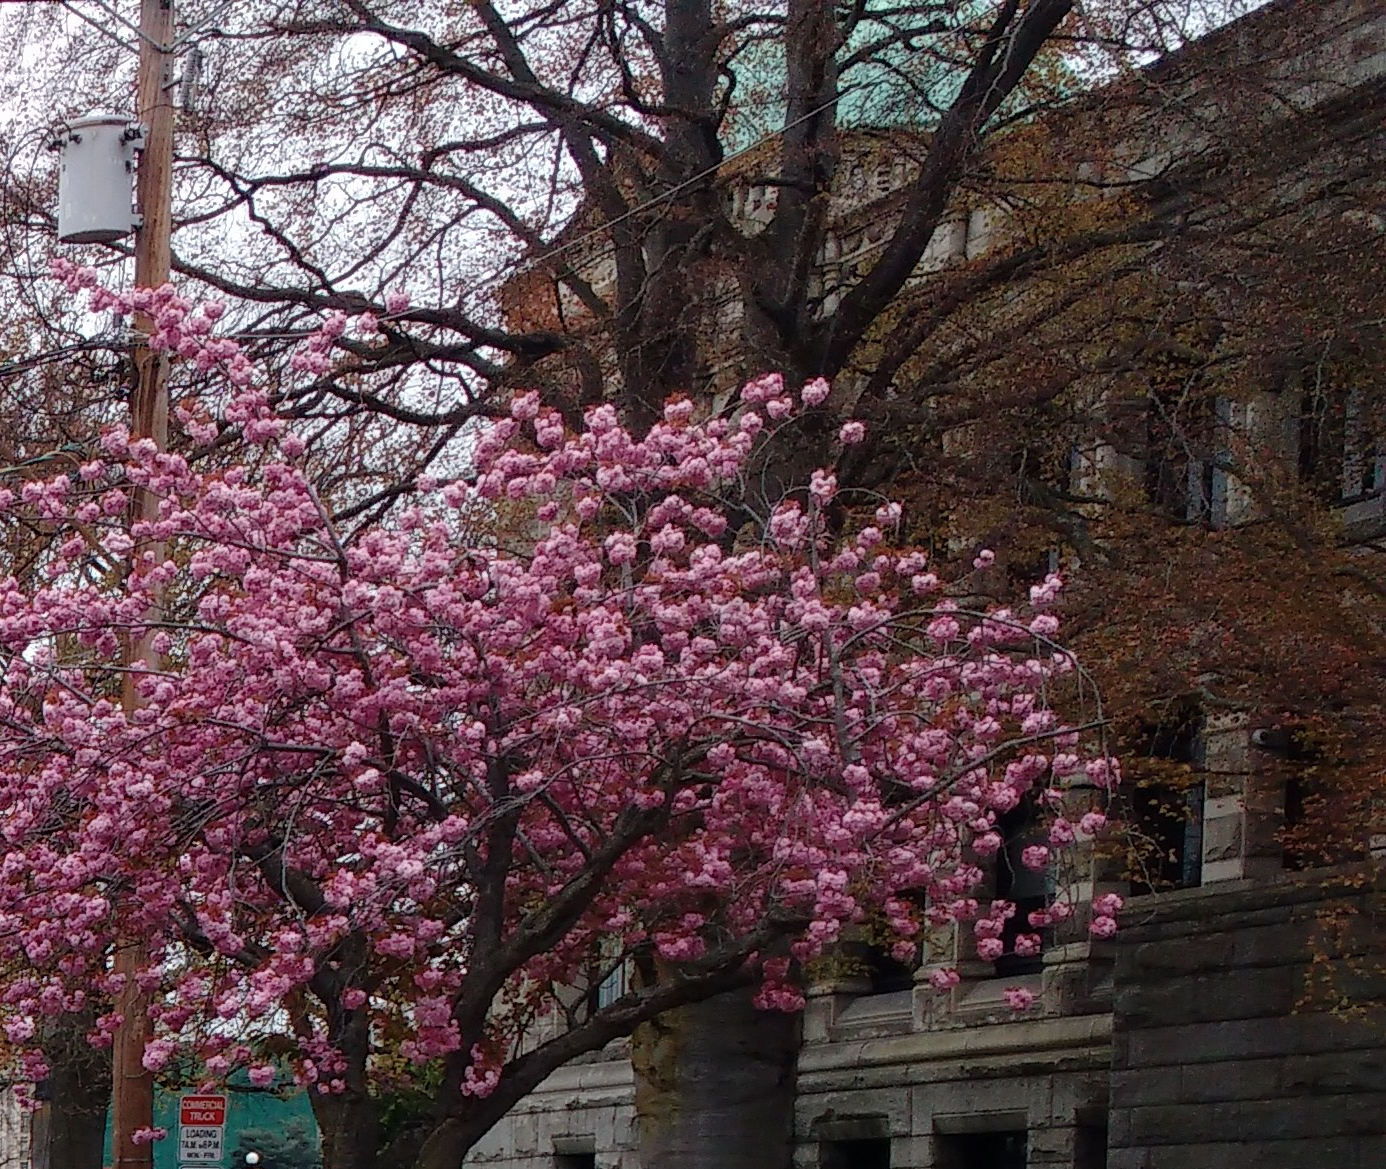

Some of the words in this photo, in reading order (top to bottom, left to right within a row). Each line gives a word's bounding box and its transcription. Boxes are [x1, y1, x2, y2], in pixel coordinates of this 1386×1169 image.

[183, 1101, 225, 1109] COMMERCIAL
[190, 1111, 215, 1121] TRUCK
[186, 1130, 217, 1138] LOADING
